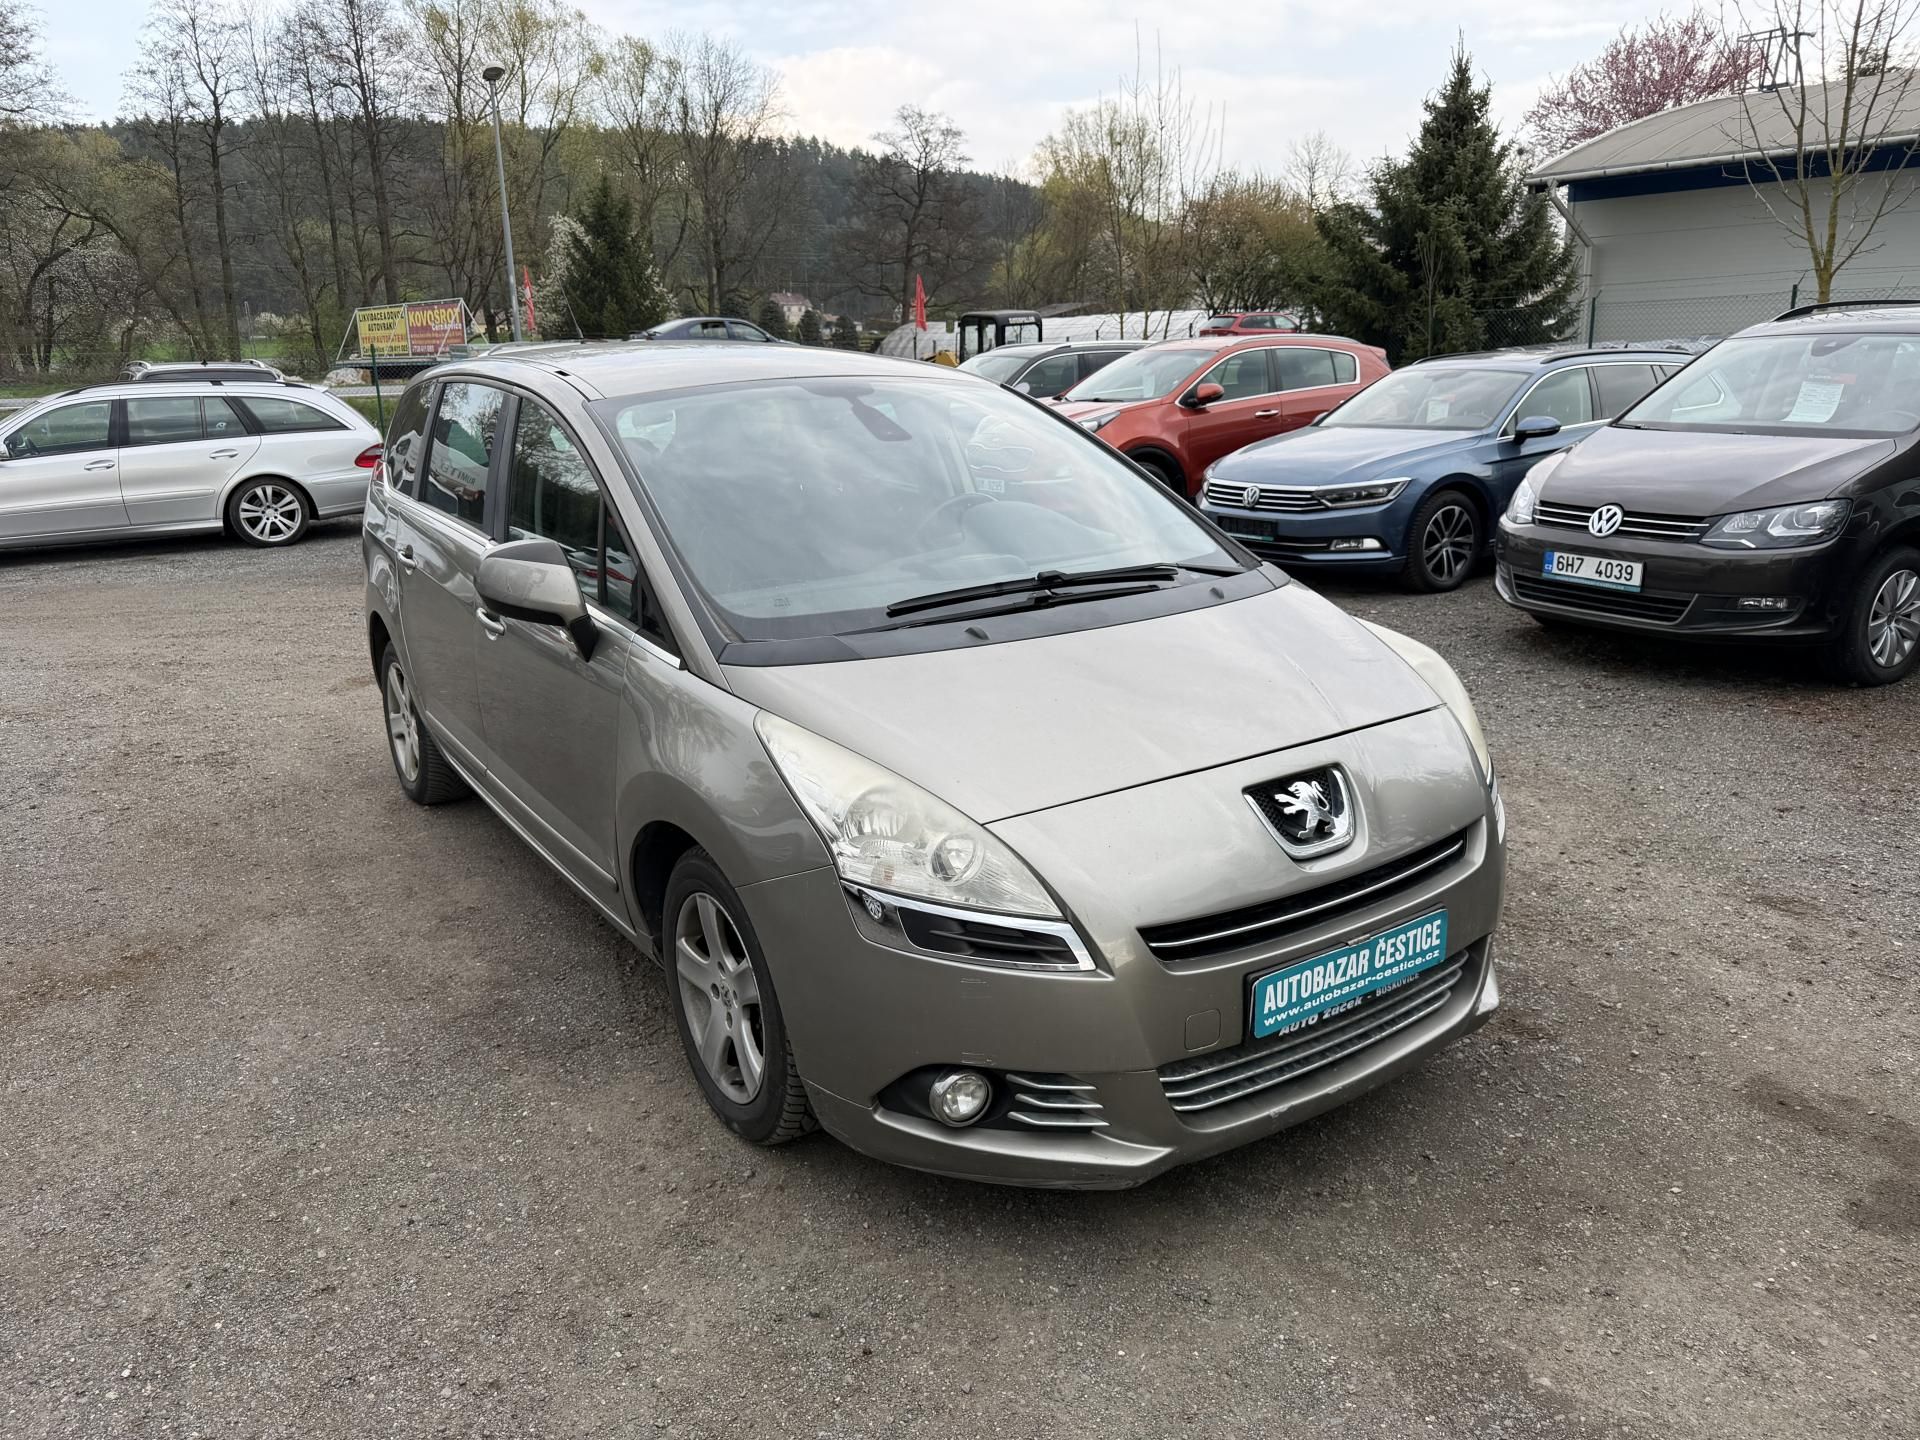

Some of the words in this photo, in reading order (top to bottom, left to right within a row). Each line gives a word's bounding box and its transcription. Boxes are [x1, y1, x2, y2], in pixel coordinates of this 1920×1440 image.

[408, 306, 461, 327] KOVOŠROT
[1556, 554, 1585, 574] 6H7
[1595, 560, 1634, 582] 4039
[1263, 949, 1370, 1014] AUTOBAZAR
[1374, 919, 1442, 969] ČESTICE
[1263, 949, 1440, 1027] www.autobazar-cestice.cz
